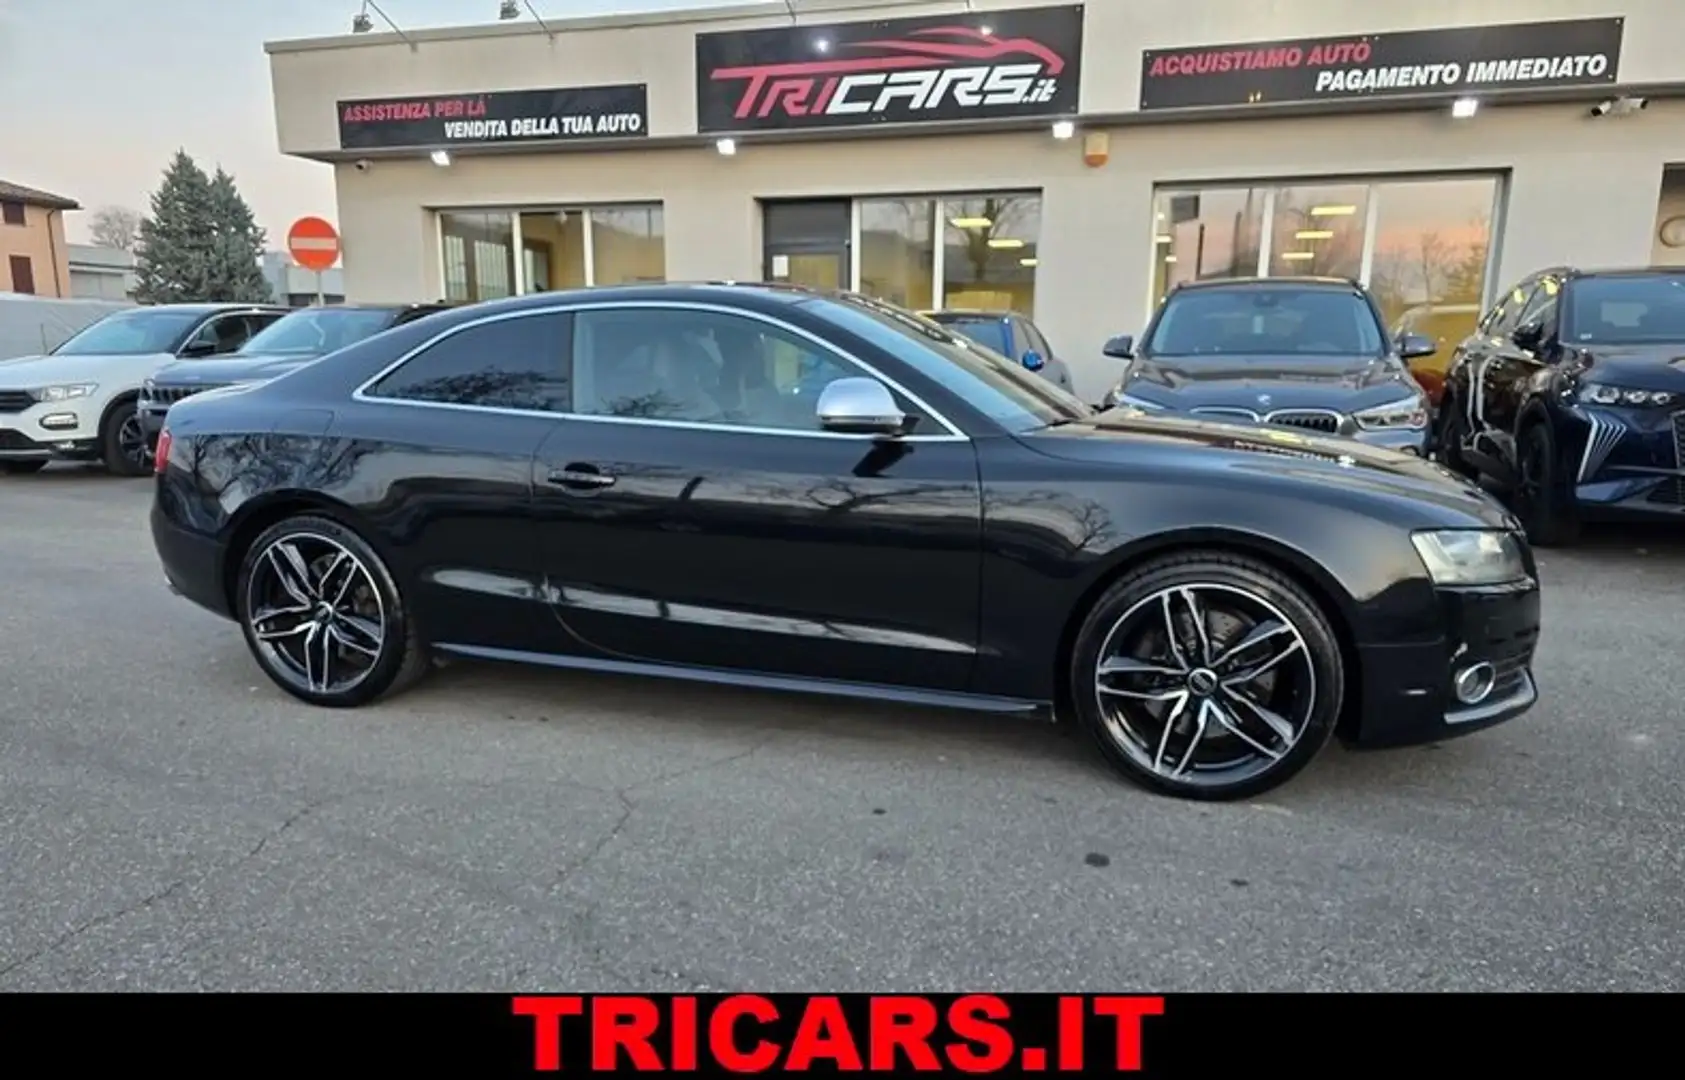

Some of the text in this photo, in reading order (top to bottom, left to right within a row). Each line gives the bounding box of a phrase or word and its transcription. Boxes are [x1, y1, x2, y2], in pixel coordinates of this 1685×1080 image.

[1149, 47, 1302, 77] ACQUISTIAMO
[1316, 54, 1608, 92] PAGAMENTO IMMEDIATO
[343, 102, 431, 121] ASSISTENZA
[434, 100, 464, 118] PER
[444, 113, 641, 139] VENDITA DELLA TUA AUTO
